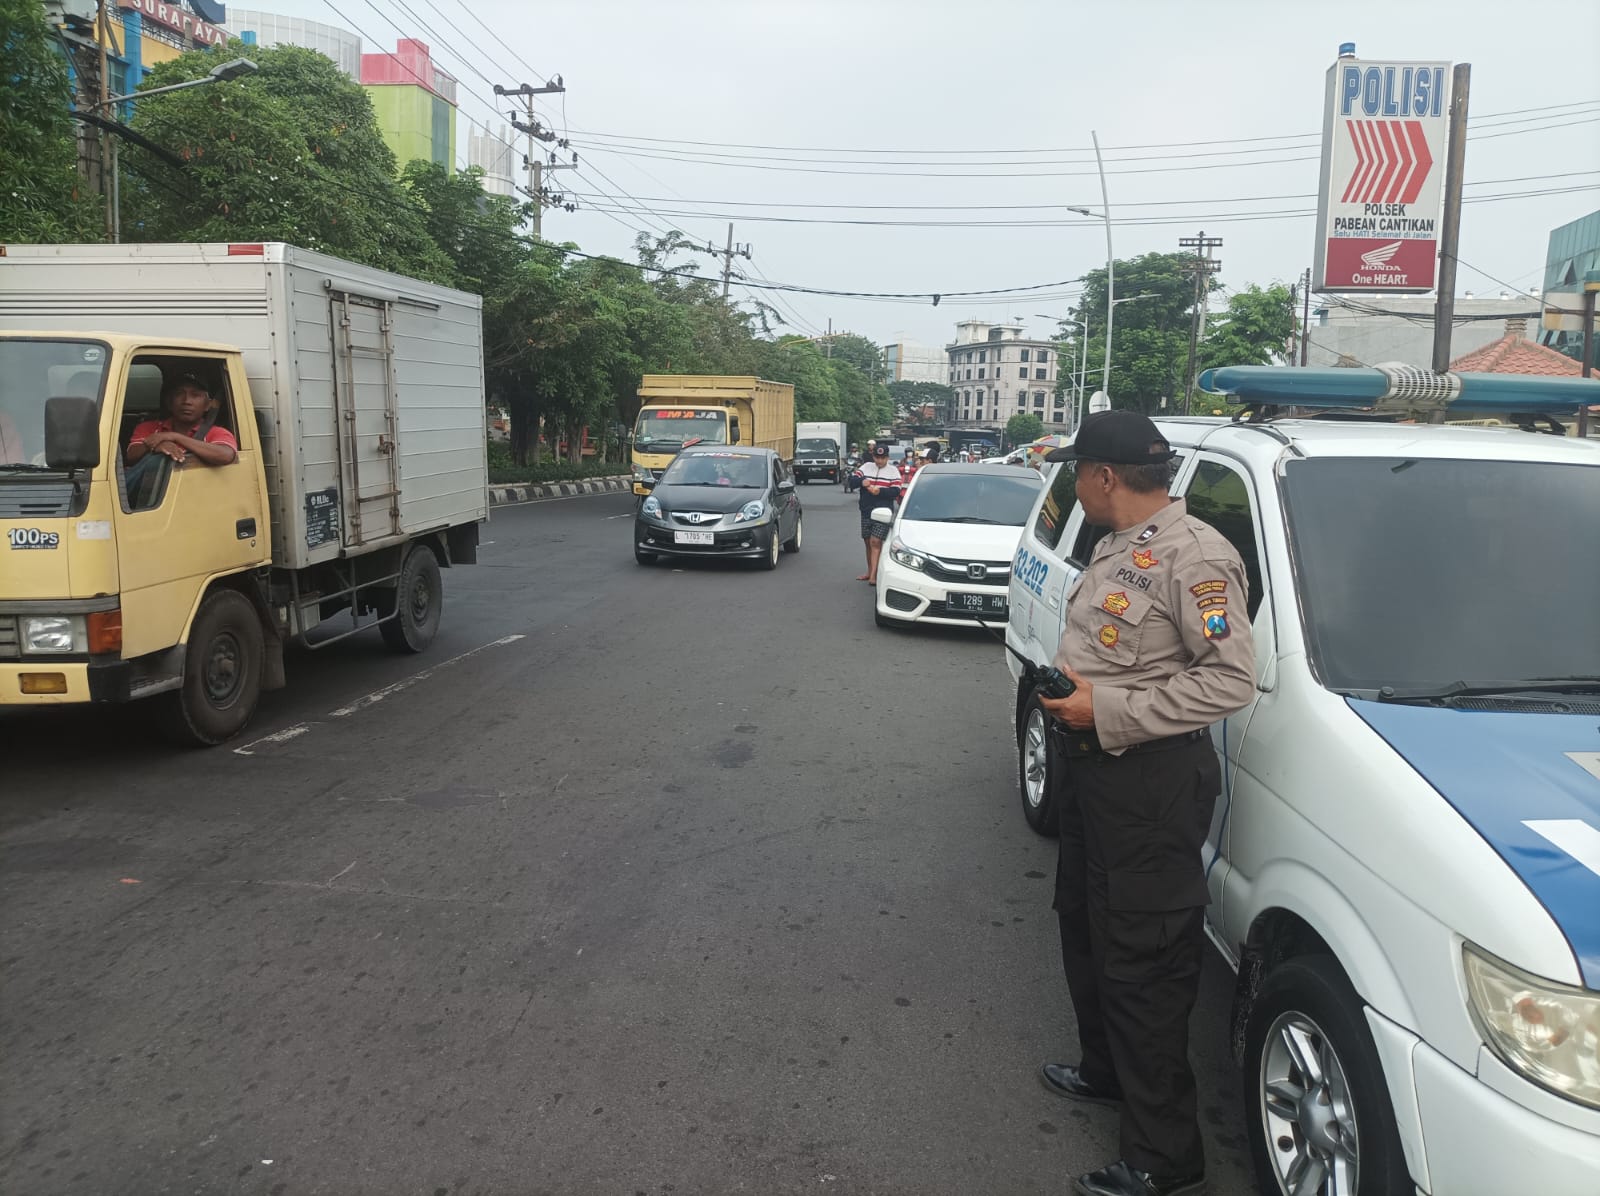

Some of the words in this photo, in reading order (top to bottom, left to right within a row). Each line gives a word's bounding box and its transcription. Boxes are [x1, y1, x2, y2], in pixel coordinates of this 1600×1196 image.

[1341, 67, 1444, 117] POLISI
[1364, 203, 1406, 216] POLSEK
[1334, 217, 1376, 231] PABEAN
[1379, 218, 1434, 232] CANTIKAN
[1360, 264, 1402, 272] HONDA
[1352, 273, 1373, 284] One
[8, 528, 59, 545] 100PS
[1014, 547, 1049, 597] 32-202
[1115, 567, 1153, 592] POLISI
[949, 594, 955, 604] L
[963, 594, 983, 606] 1289
